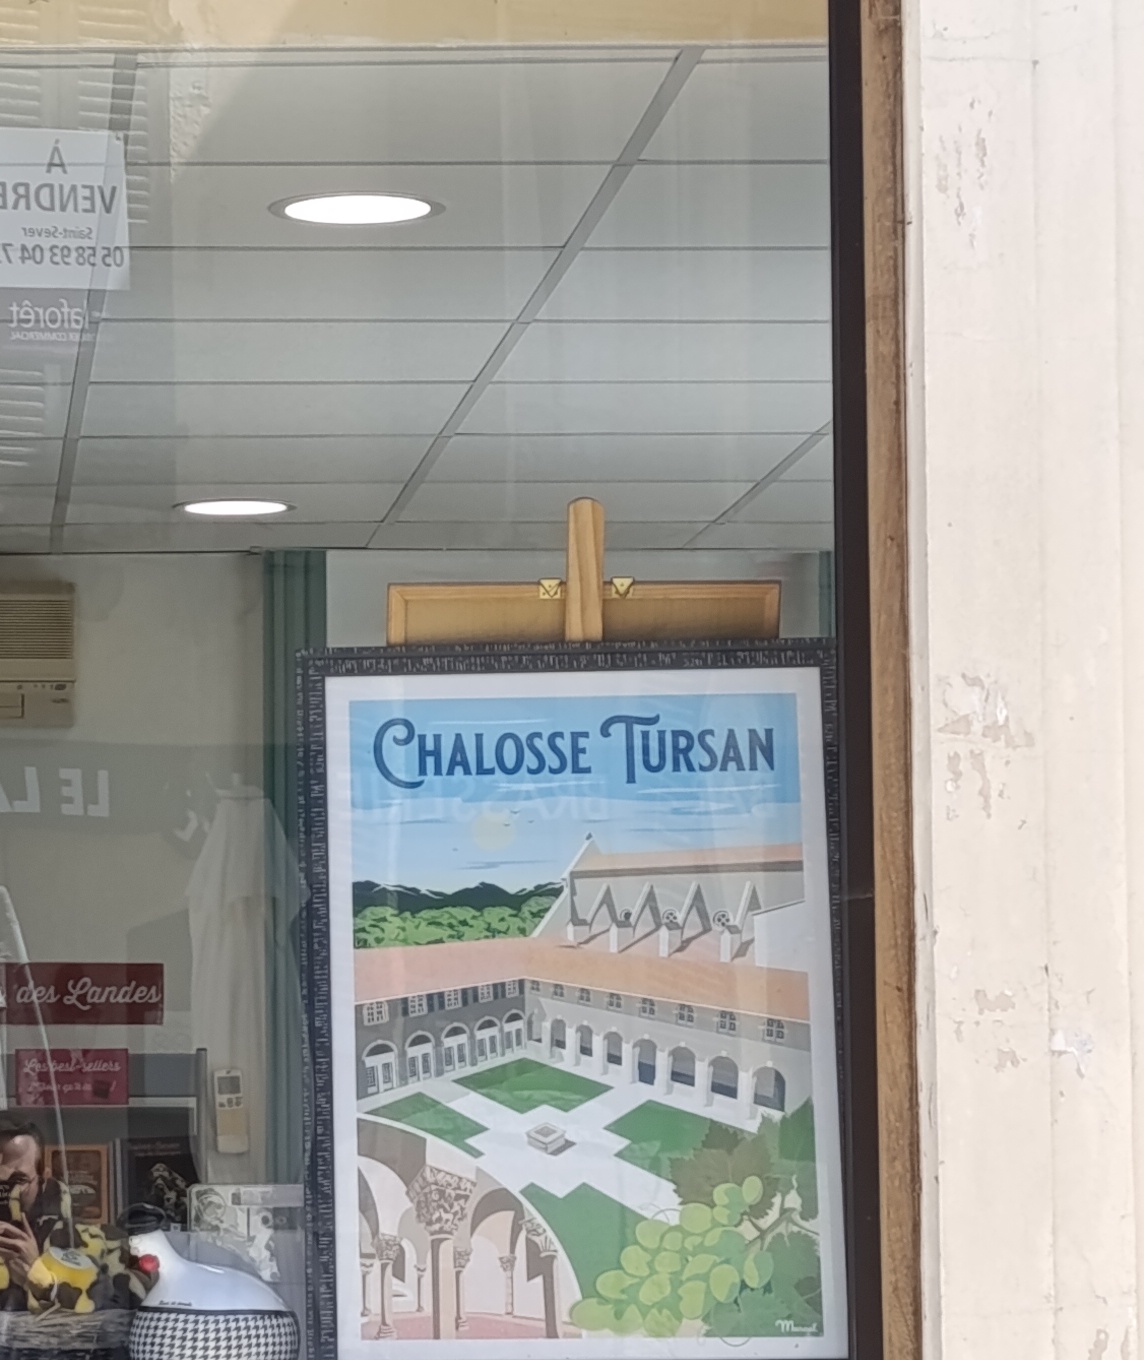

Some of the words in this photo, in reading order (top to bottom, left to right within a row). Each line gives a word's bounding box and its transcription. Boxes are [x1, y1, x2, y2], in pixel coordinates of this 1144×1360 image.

[372, 717, 593, 790] CHALOSSE
[599, 713, 776, 784] TURSAN
[62, 977, 163, 1009] Landes
